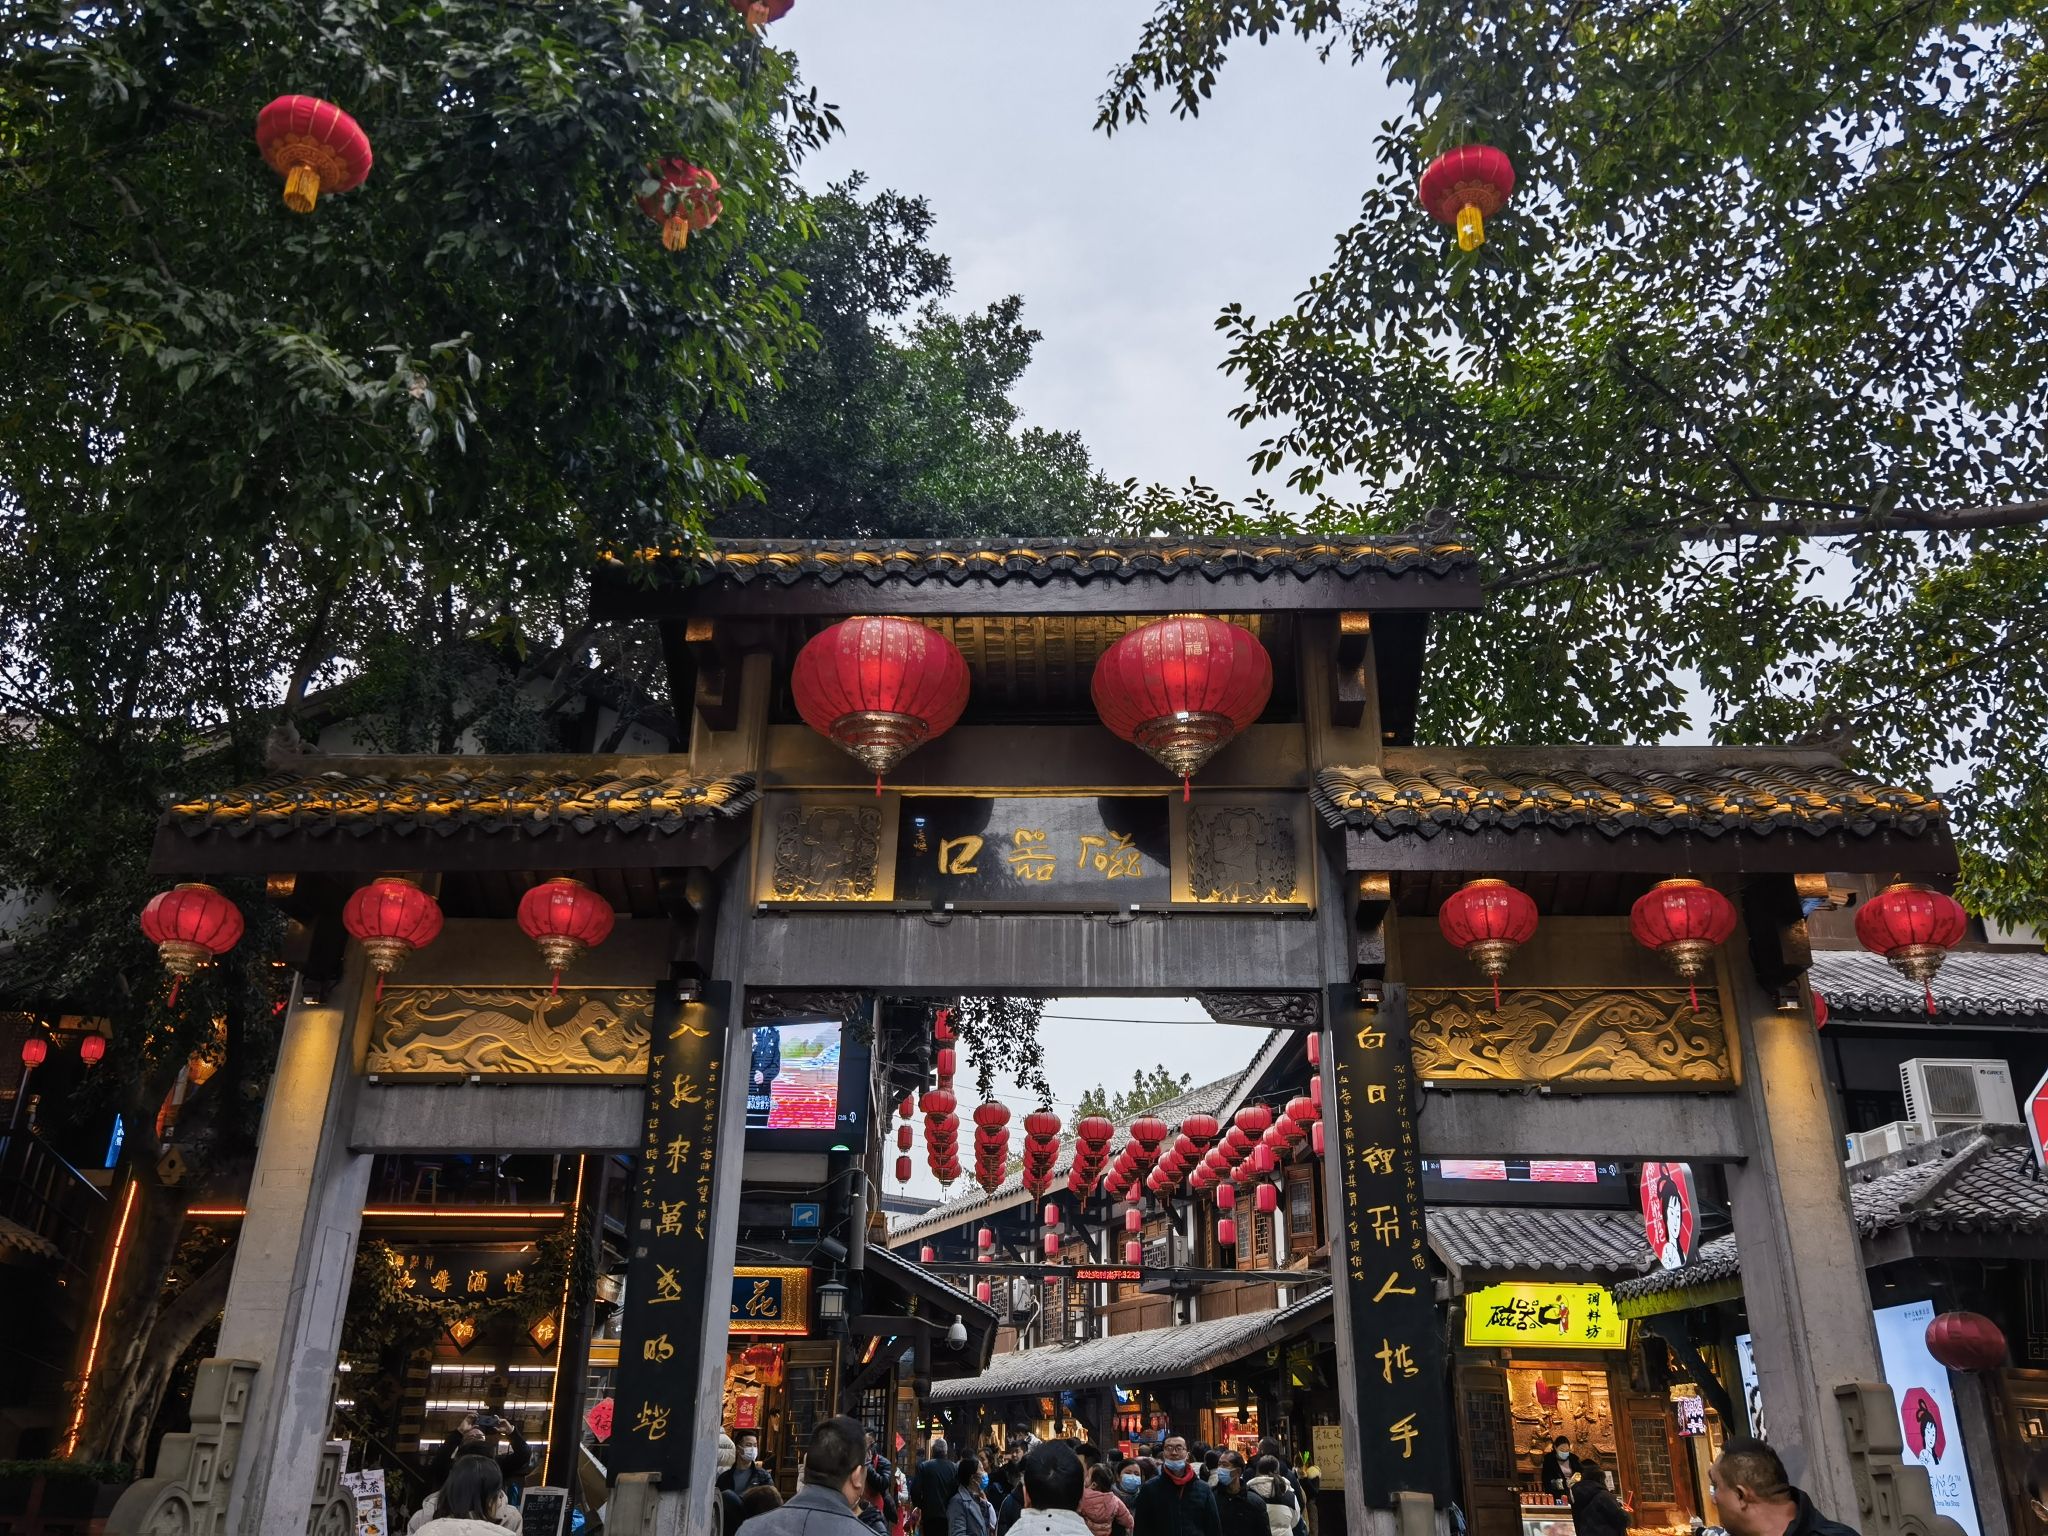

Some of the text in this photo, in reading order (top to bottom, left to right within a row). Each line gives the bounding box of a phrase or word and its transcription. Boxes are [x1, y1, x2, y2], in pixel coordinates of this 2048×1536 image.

[455, 1323, 474, 1338] 酒
[1585, 1292, 1602, 1340] 调料坊
